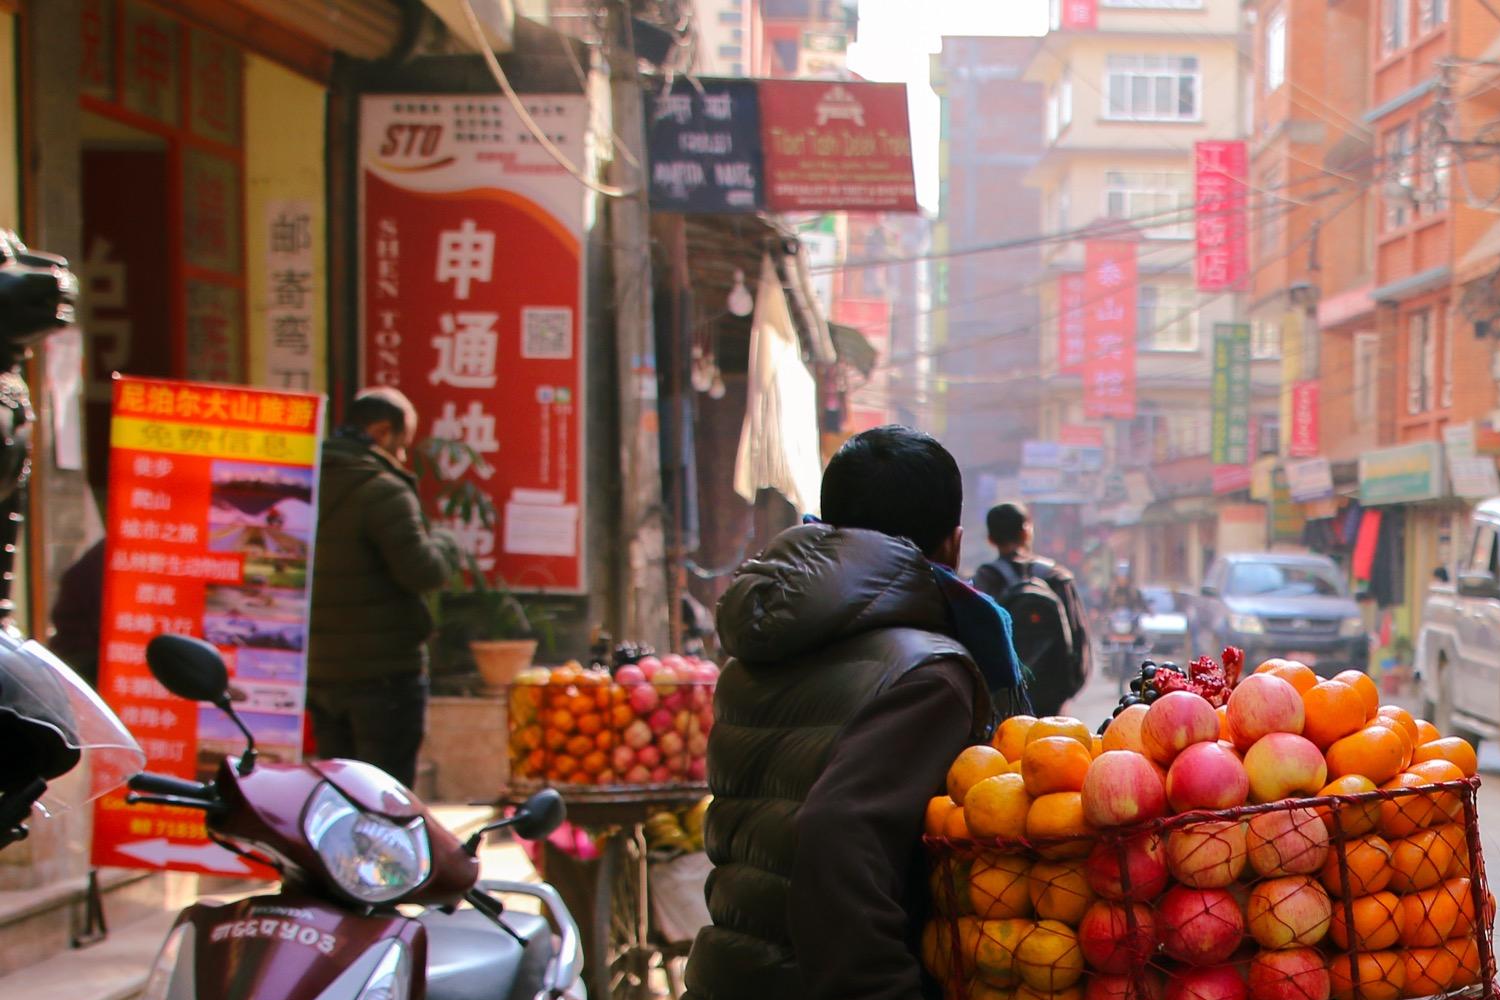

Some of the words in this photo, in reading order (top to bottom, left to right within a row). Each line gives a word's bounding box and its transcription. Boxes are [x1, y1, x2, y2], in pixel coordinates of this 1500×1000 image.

[380, 124, 443, 156] STO
[118, 383, 314, 428] 尼泊尔大山旅游
[141, 424, 294, 458] 免费信息
